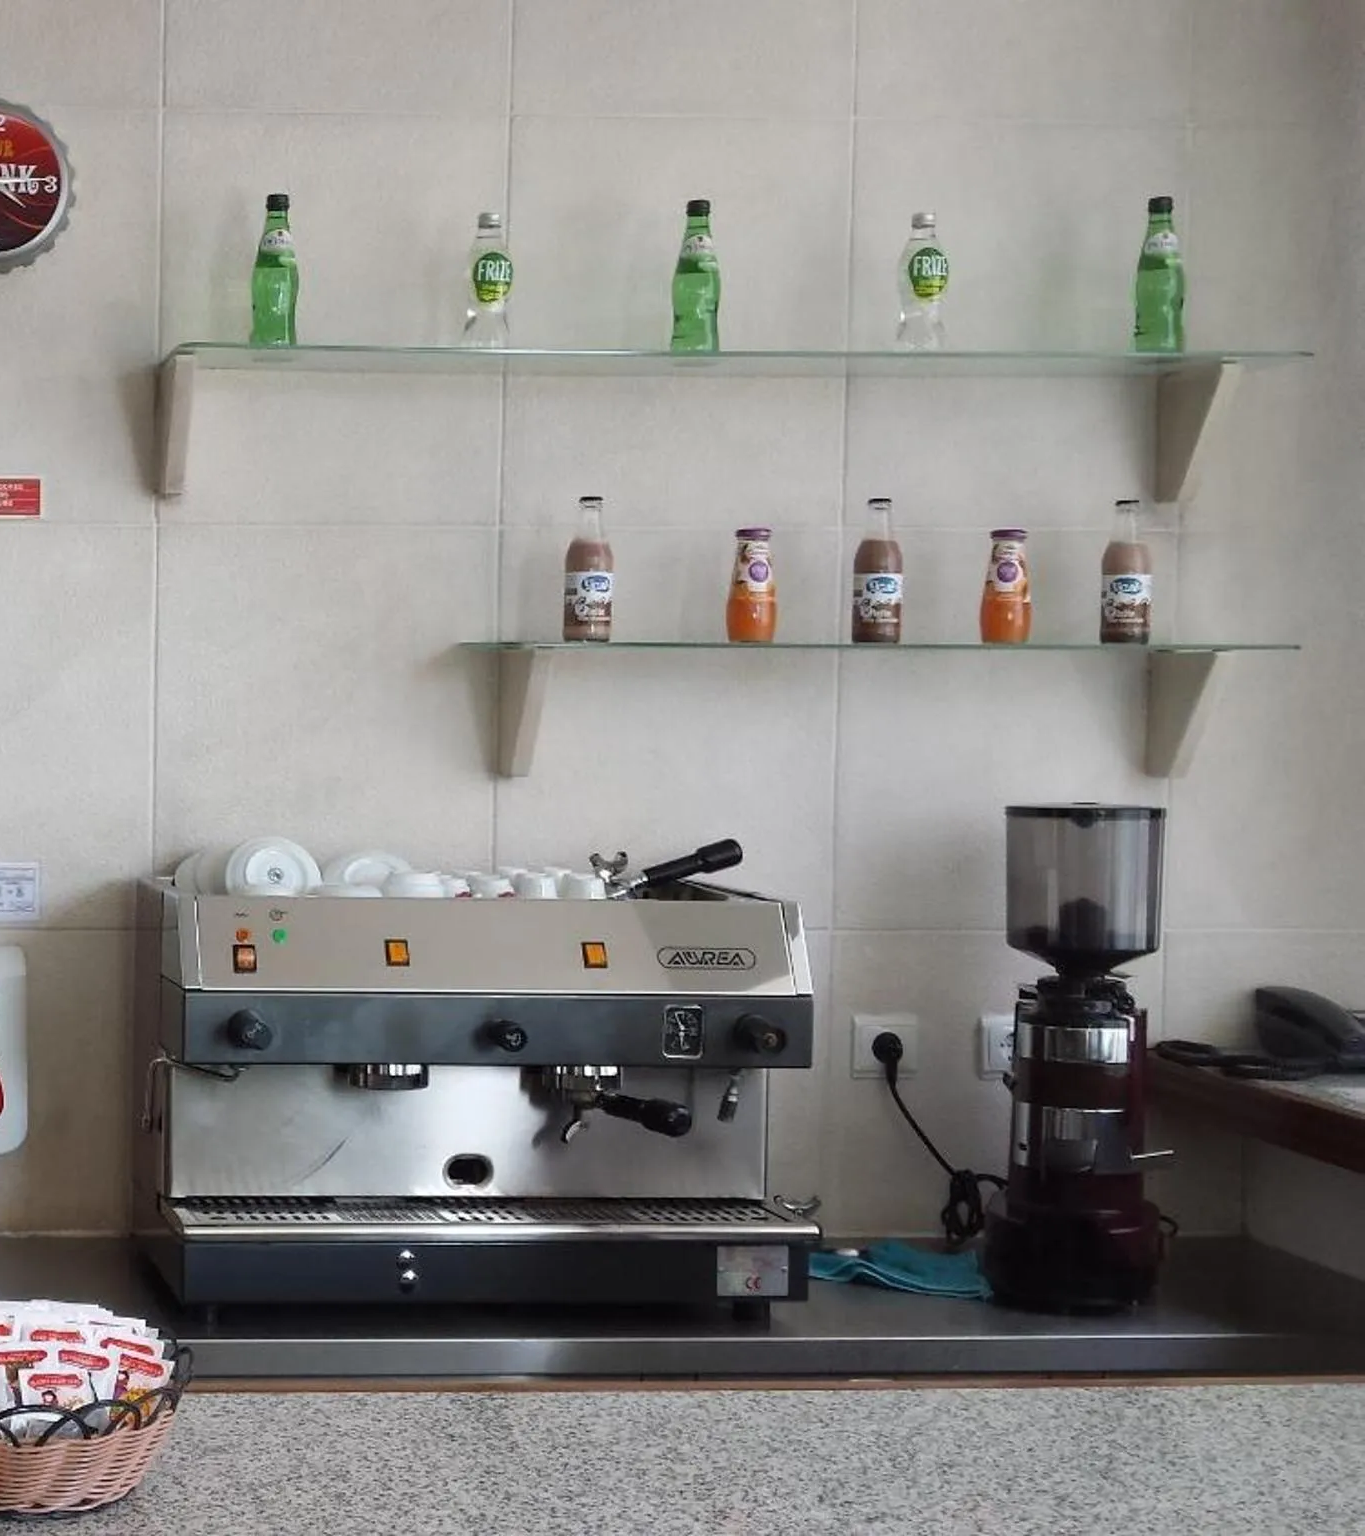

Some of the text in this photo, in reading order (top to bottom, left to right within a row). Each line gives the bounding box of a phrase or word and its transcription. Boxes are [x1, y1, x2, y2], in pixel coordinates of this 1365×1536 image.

[44, 176, 58, 193] 3
[478, 260, 511, 283] FRIZE
[913, 256, 948, 276] FRIZE
[667, 951, 746, 967] AUREA
